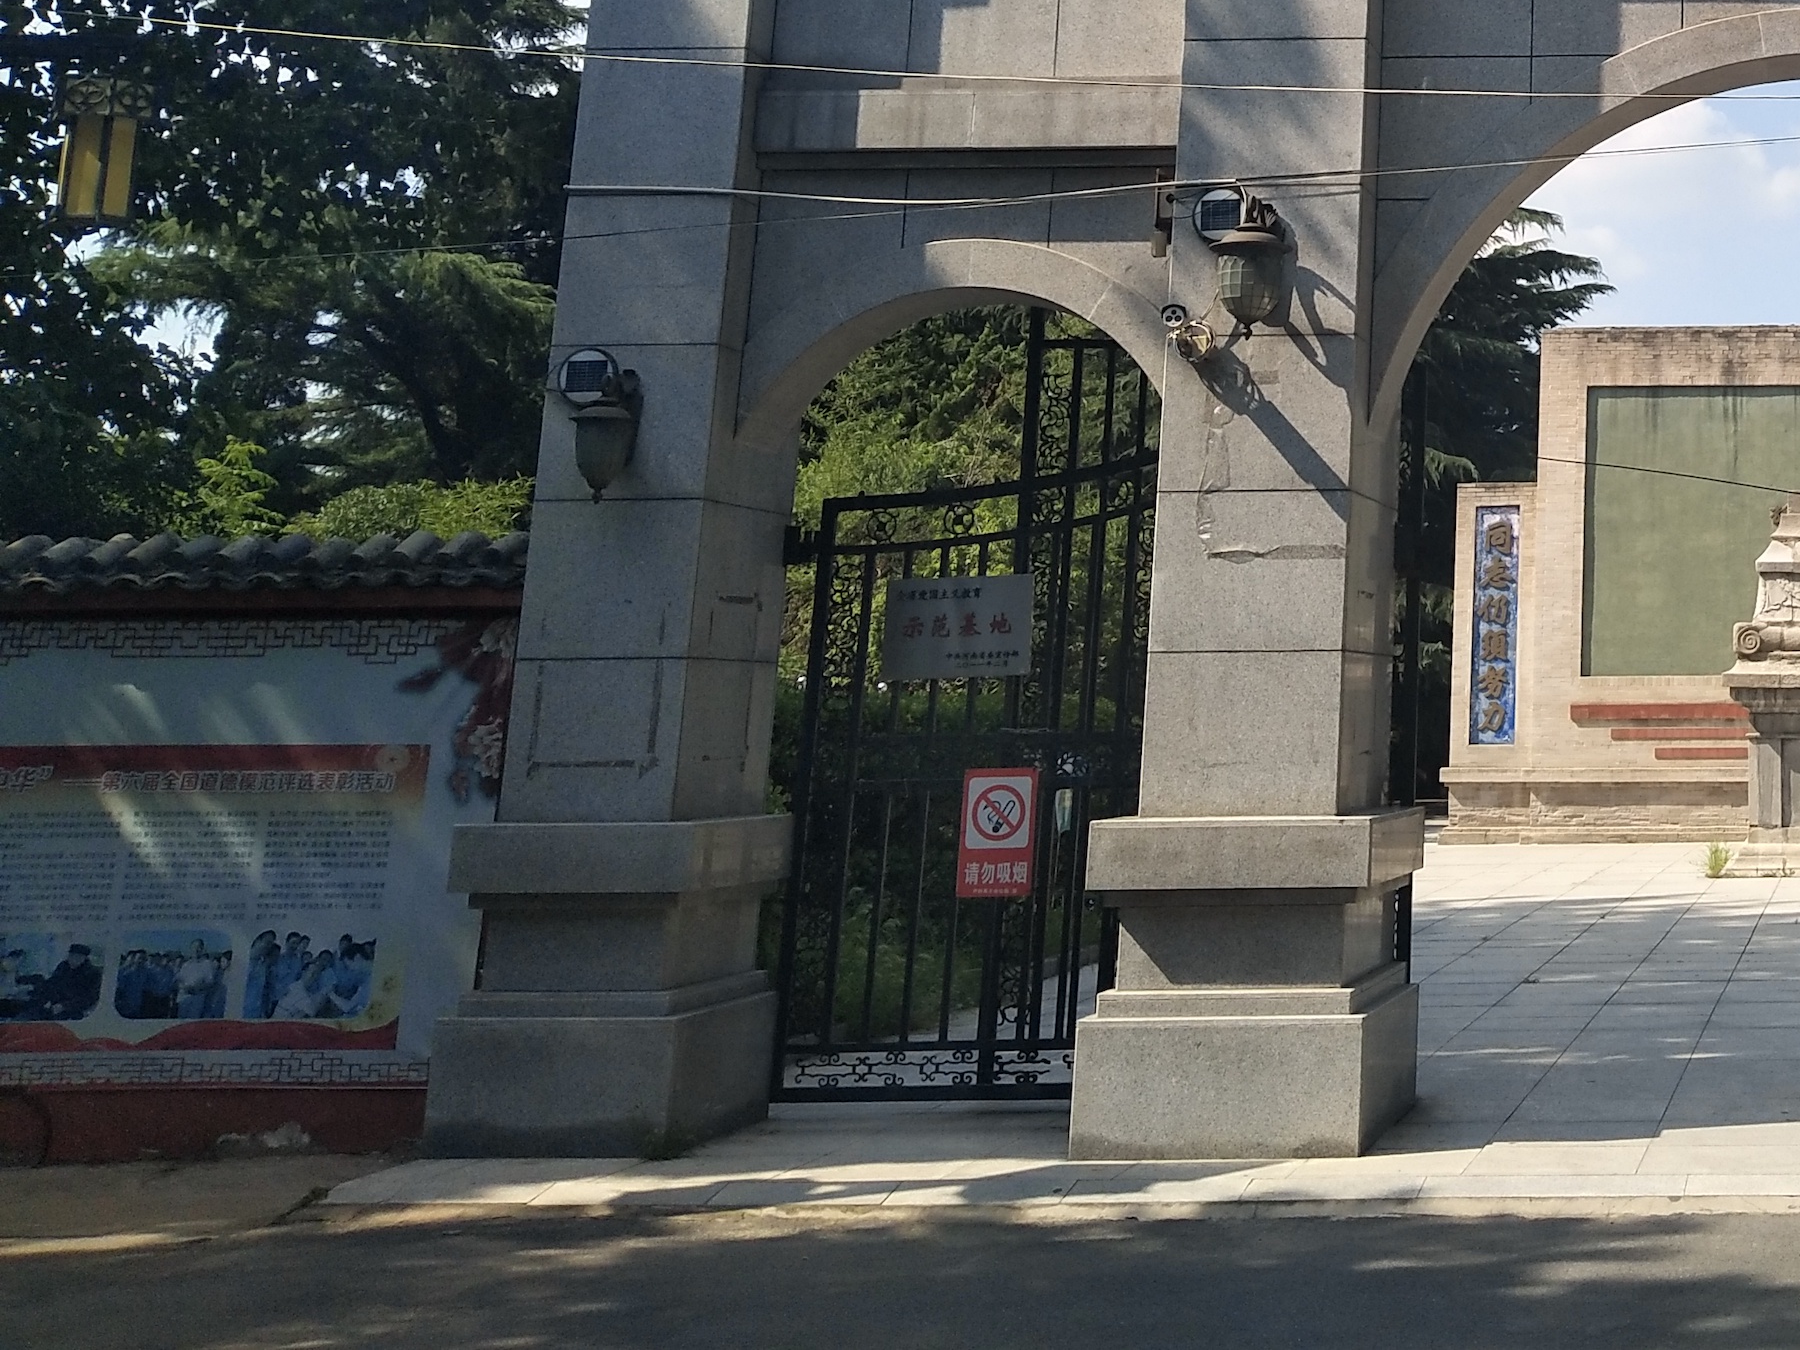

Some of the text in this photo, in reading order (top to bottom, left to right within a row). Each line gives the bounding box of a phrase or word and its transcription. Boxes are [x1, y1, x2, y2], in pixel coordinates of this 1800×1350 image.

[903, 611, 1013, 639] 示范基地
[964, 861, 1028, 885] 请勿吸烟
